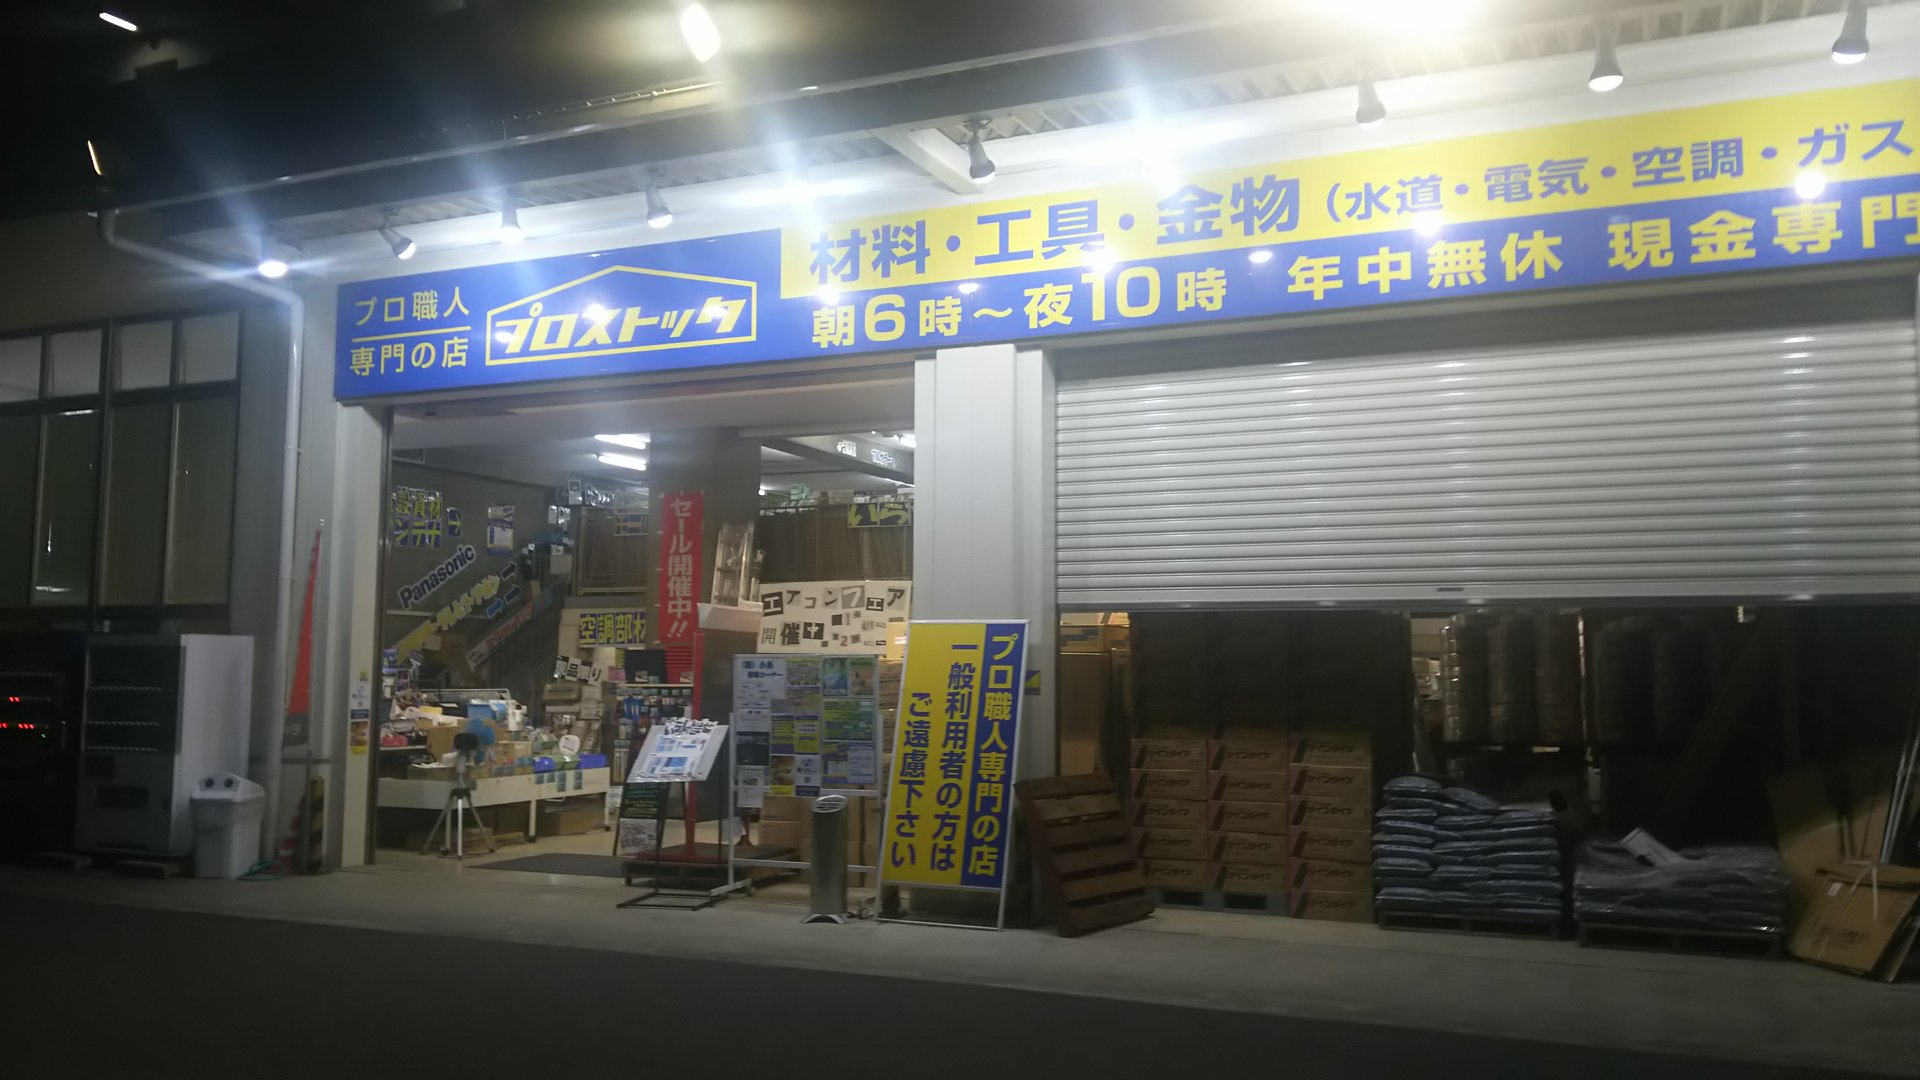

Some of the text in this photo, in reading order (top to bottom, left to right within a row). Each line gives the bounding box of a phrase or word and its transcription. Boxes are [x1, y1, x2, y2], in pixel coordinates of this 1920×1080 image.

[809, 174, 1300, 285] 材料・工具・金物
[1287, 231, 1563, 300] 年中無休
[1607, 192, 1920, 271] 現金専門
[350, 336, 469, 376] 専門の店
[354, 286, 470, 326] プロ職人
[495, 296, 747, 354] プロストック
[400, 545, 475, 606] Panasonic
[667, 497, 693, 640] セール開催中!!
[890, 692, 934, 868] ご遠慮下さい
[930, 644, 979, 872] 一般利用者の方は
[968, 633, 1019, 877] プロ職人専門の店
